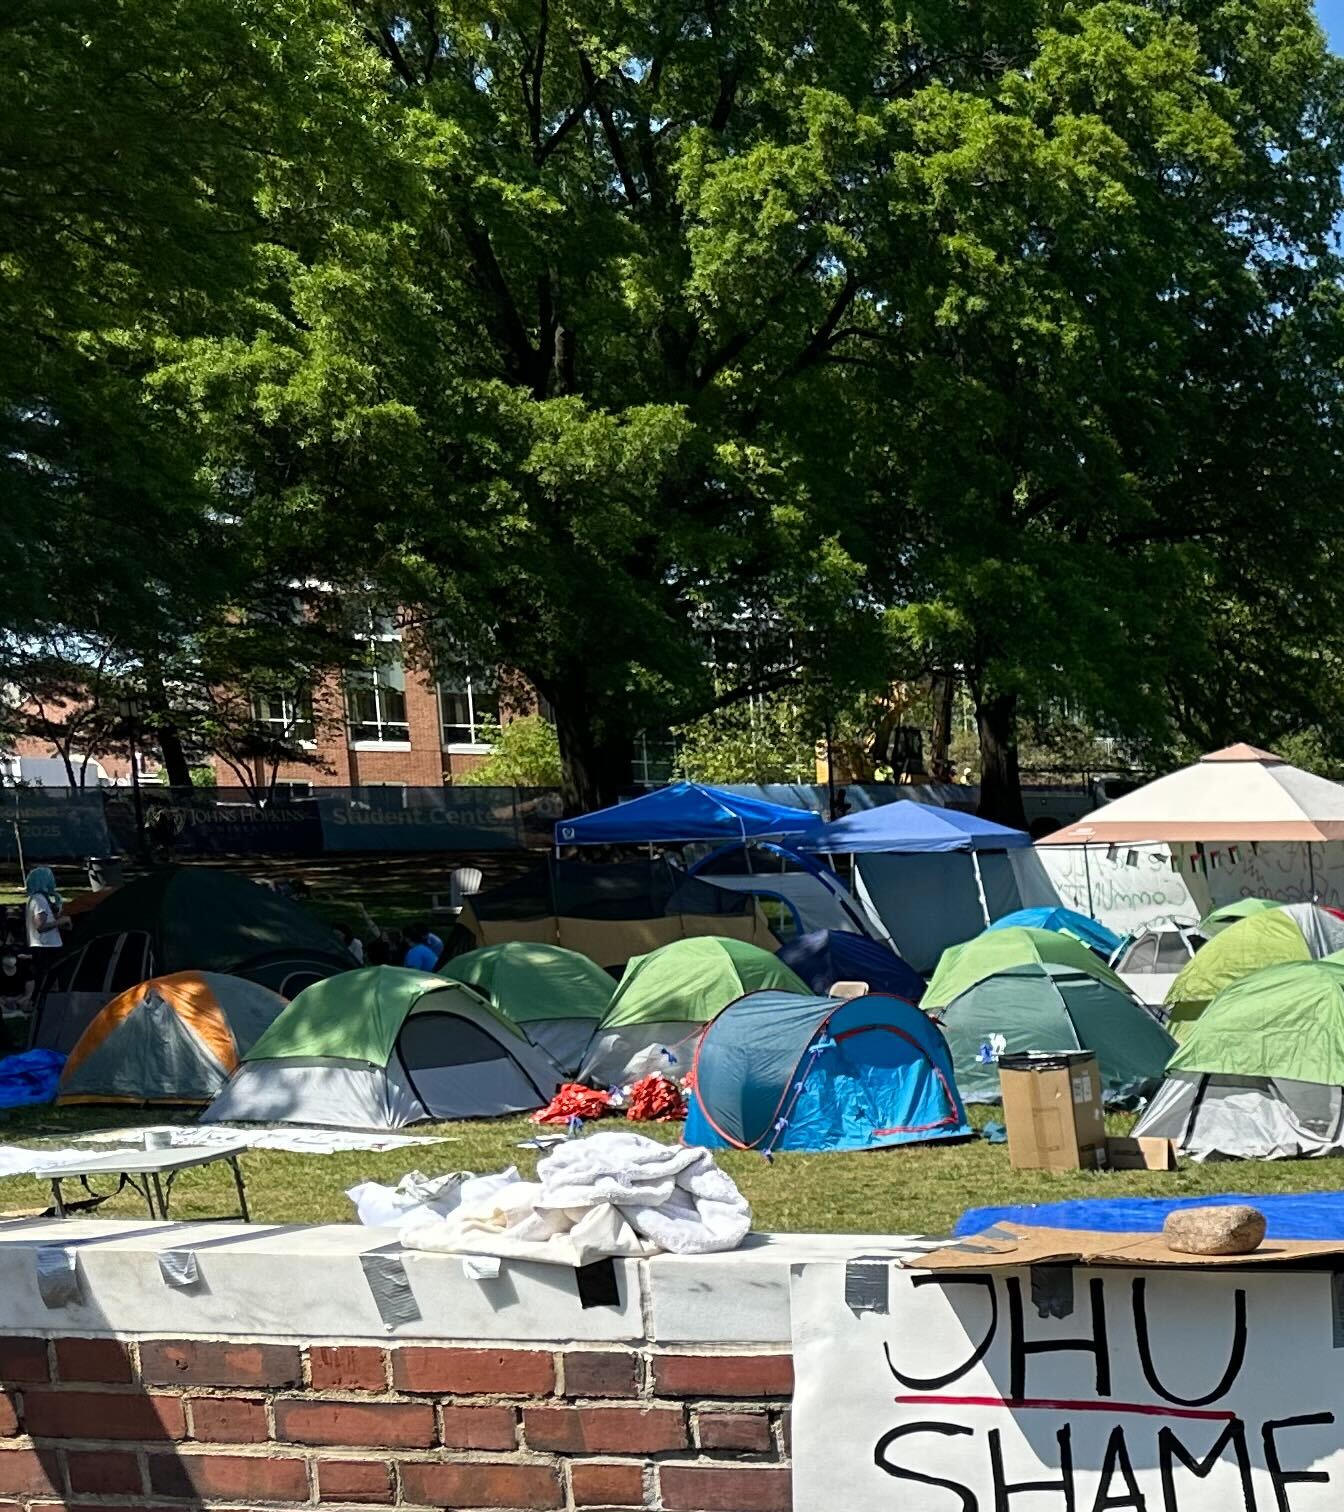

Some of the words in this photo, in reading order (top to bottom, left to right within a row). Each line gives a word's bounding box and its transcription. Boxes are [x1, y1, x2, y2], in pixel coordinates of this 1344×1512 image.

[332, 807, 424, 826] Student
[429, 807, 513, 826] Cente
[884, 1272, 1247, 1408] JHU
